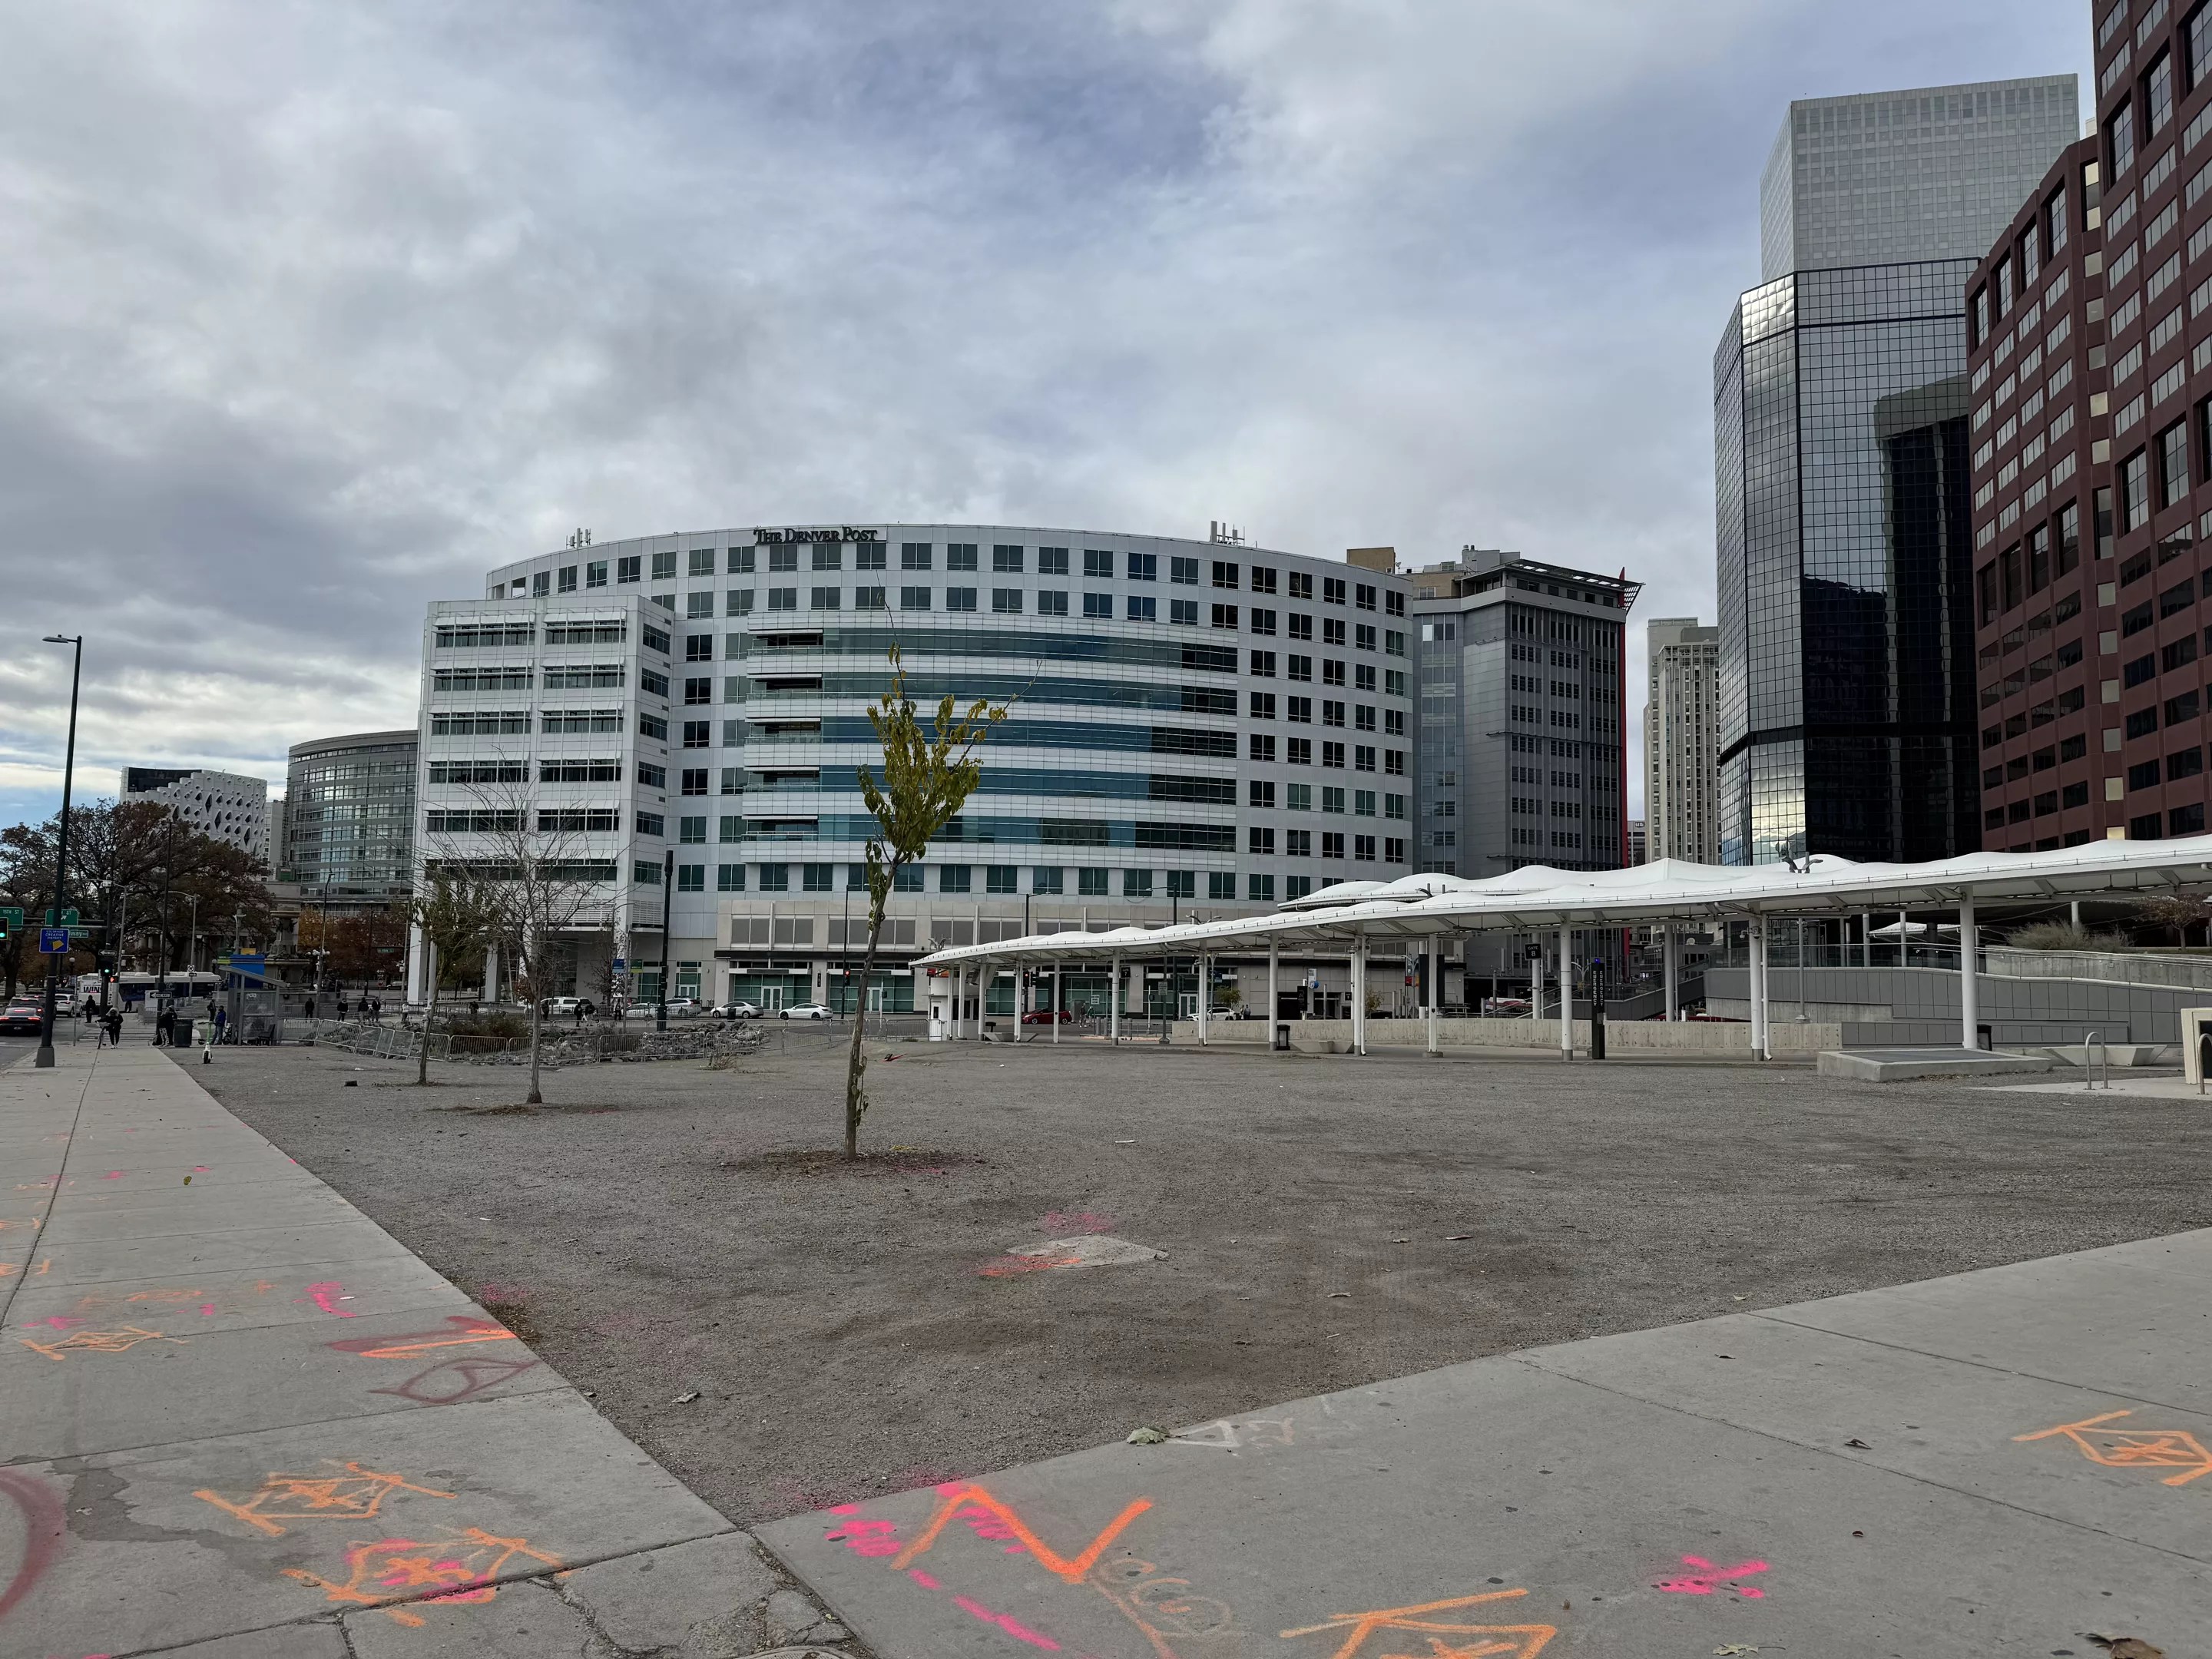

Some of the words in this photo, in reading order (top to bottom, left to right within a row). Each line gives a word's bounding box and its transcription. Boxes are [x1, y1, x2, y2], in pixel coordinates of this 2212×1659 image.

[753, 528, 782, 544] THE
[783, 528, 842, 543] DENVER
[842, 526, 877, 541] POST
